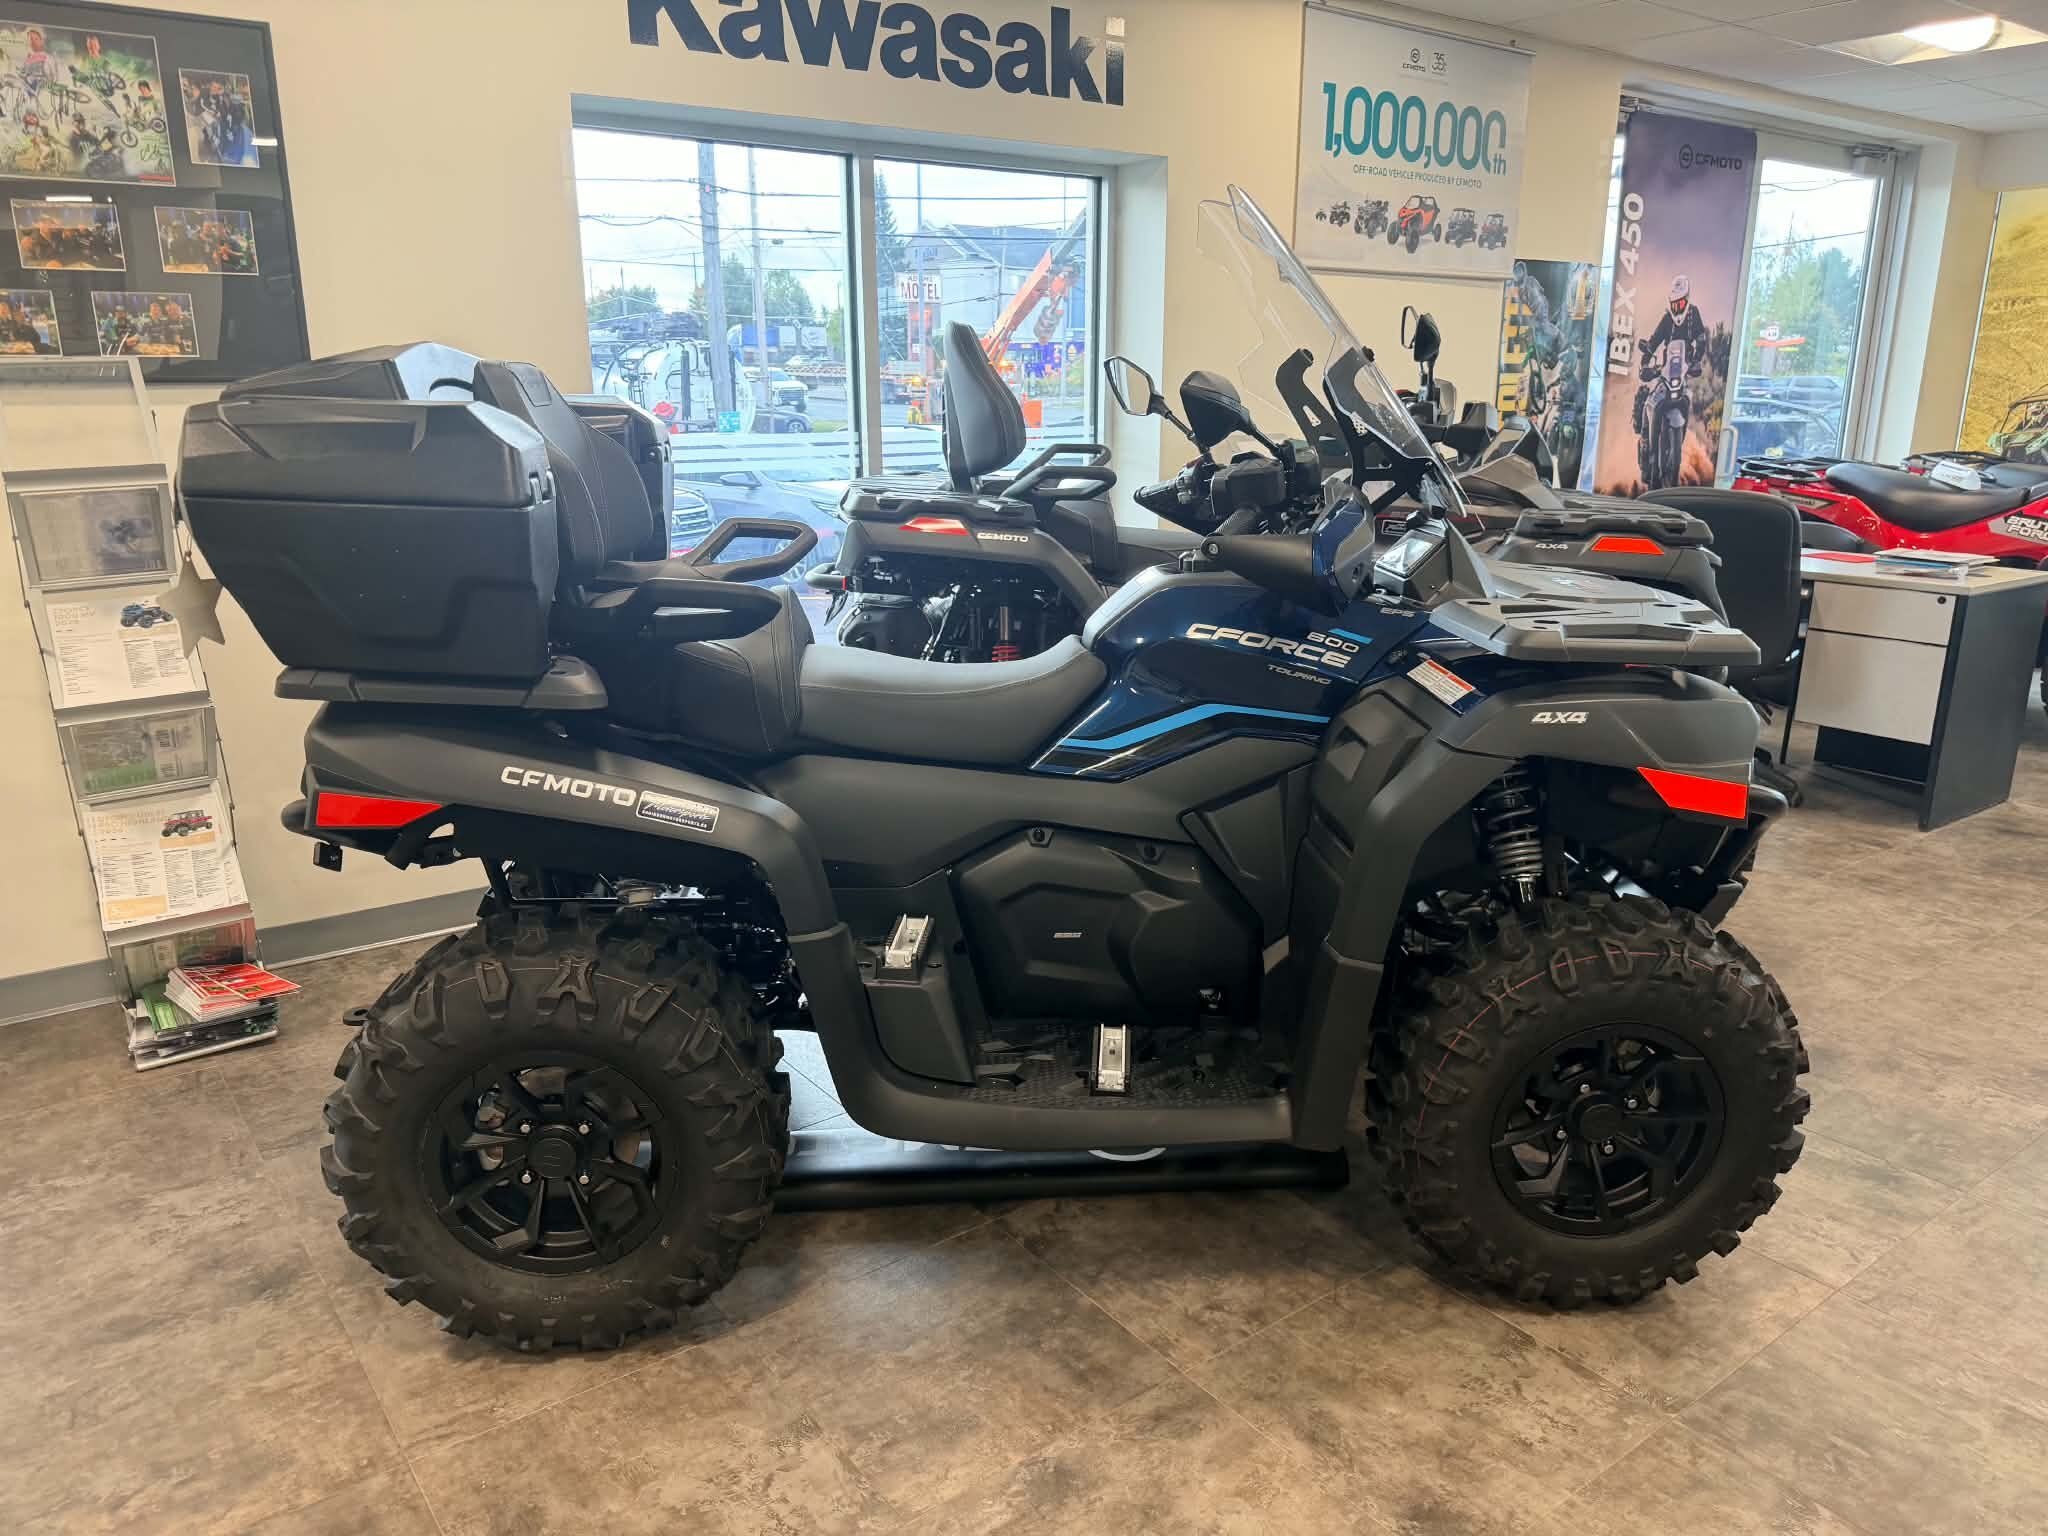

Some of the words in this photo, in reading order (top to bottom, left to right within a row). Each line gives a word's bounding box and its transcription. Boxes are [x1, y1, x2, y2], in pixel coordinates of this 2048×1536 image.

[1353, 164, 1388, 177] OFF-ROAD
[1388, 169, 1415, 180] VEHICLE
[1695, 153, 1743, 170] CFMOTO
[1619, 192, 1645, 276] 450
[1607, 286, 1637, 377] IBEX
[976, 532, 1029, 543] CFMOTO
[1380, 607, 1415, 618] EPS
[1184, 623, 1352, 669] CFORCE
[1306, 631, 1360, 653] 600
[1267, 664, 1333, 686] TOURING
[501, 766, 637, 807] CFMOTO
